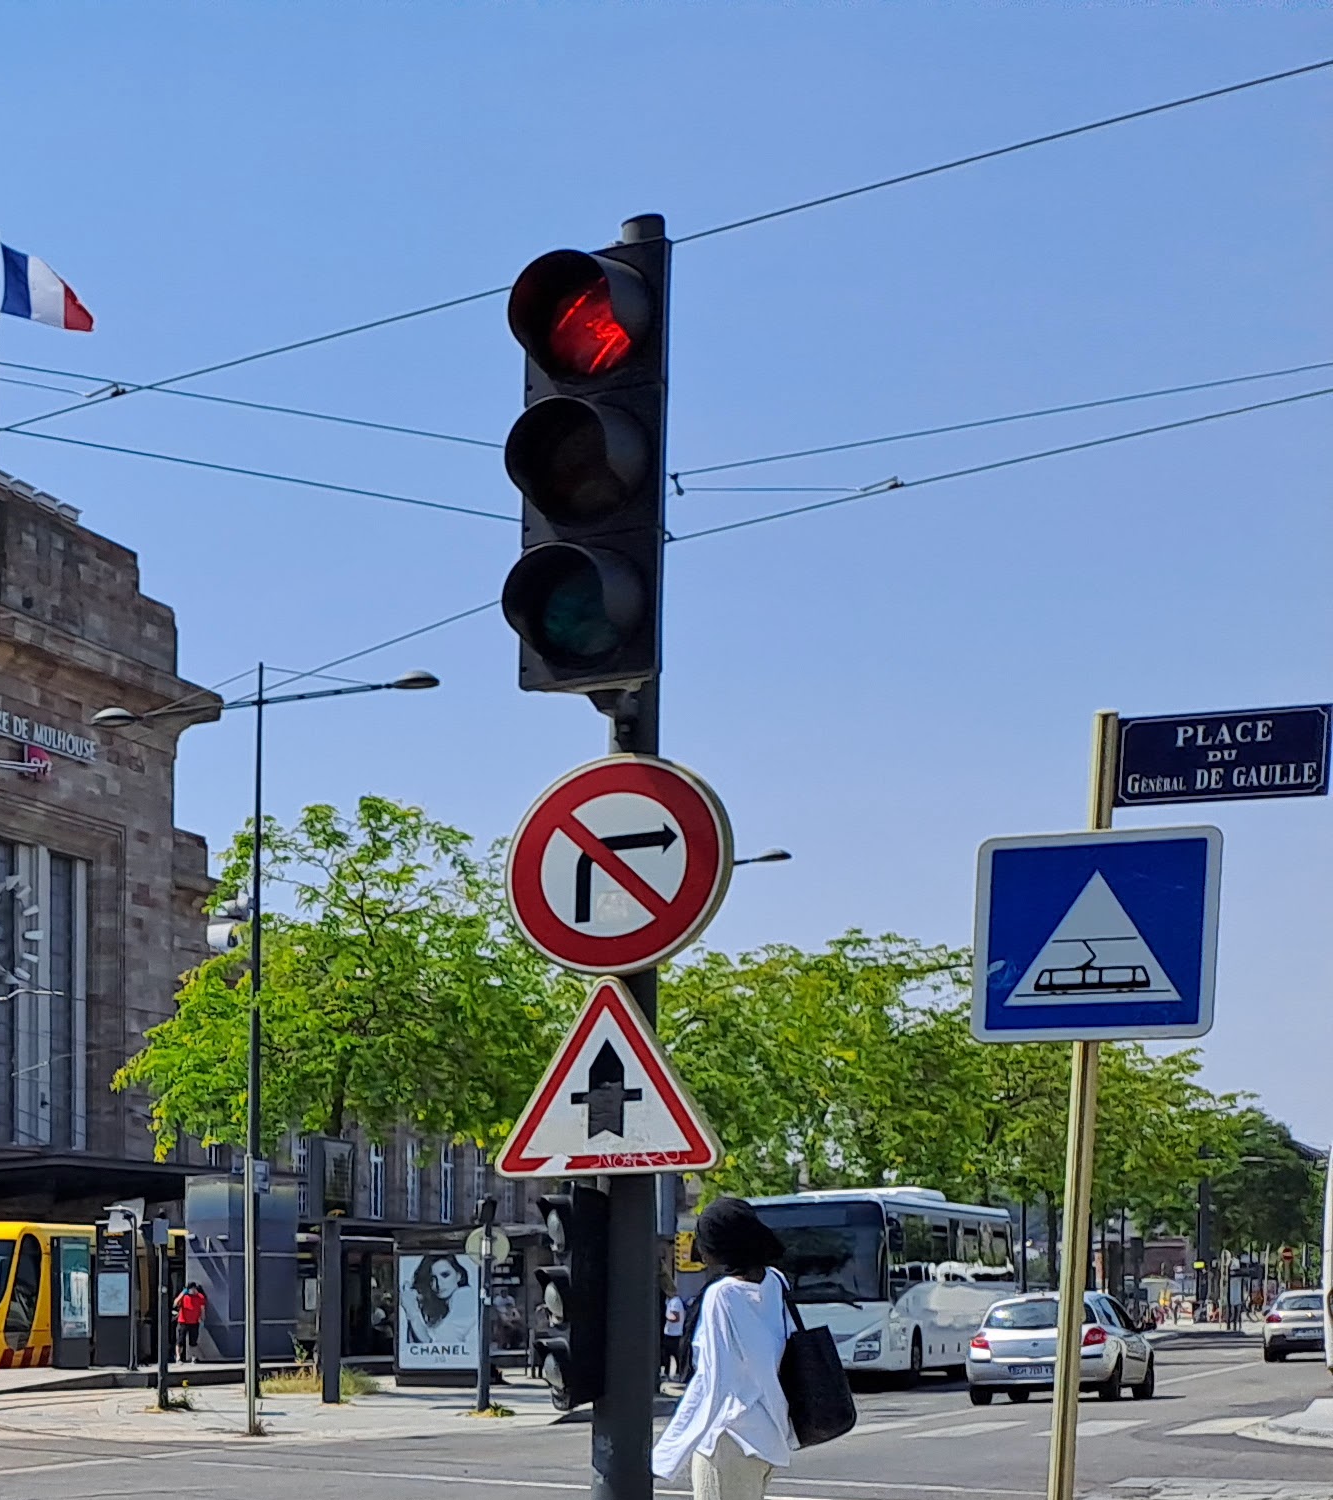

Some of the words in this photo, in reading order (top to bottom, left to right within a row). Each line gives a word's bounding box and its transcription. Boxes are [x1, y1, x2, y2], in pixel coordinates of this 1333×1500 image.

[13, 715, 29, 740] DE
[33, 722, 96, 760] MULHOUSE
[1175, 720, 1274, 748] PLACE
[1207, 750, 1238, 762] DU
[1195, 767, 1224, 790] DE
[1233, 762, 1317, 787] GAULLE
[410, 1345, 469, 1355] CHANEL
